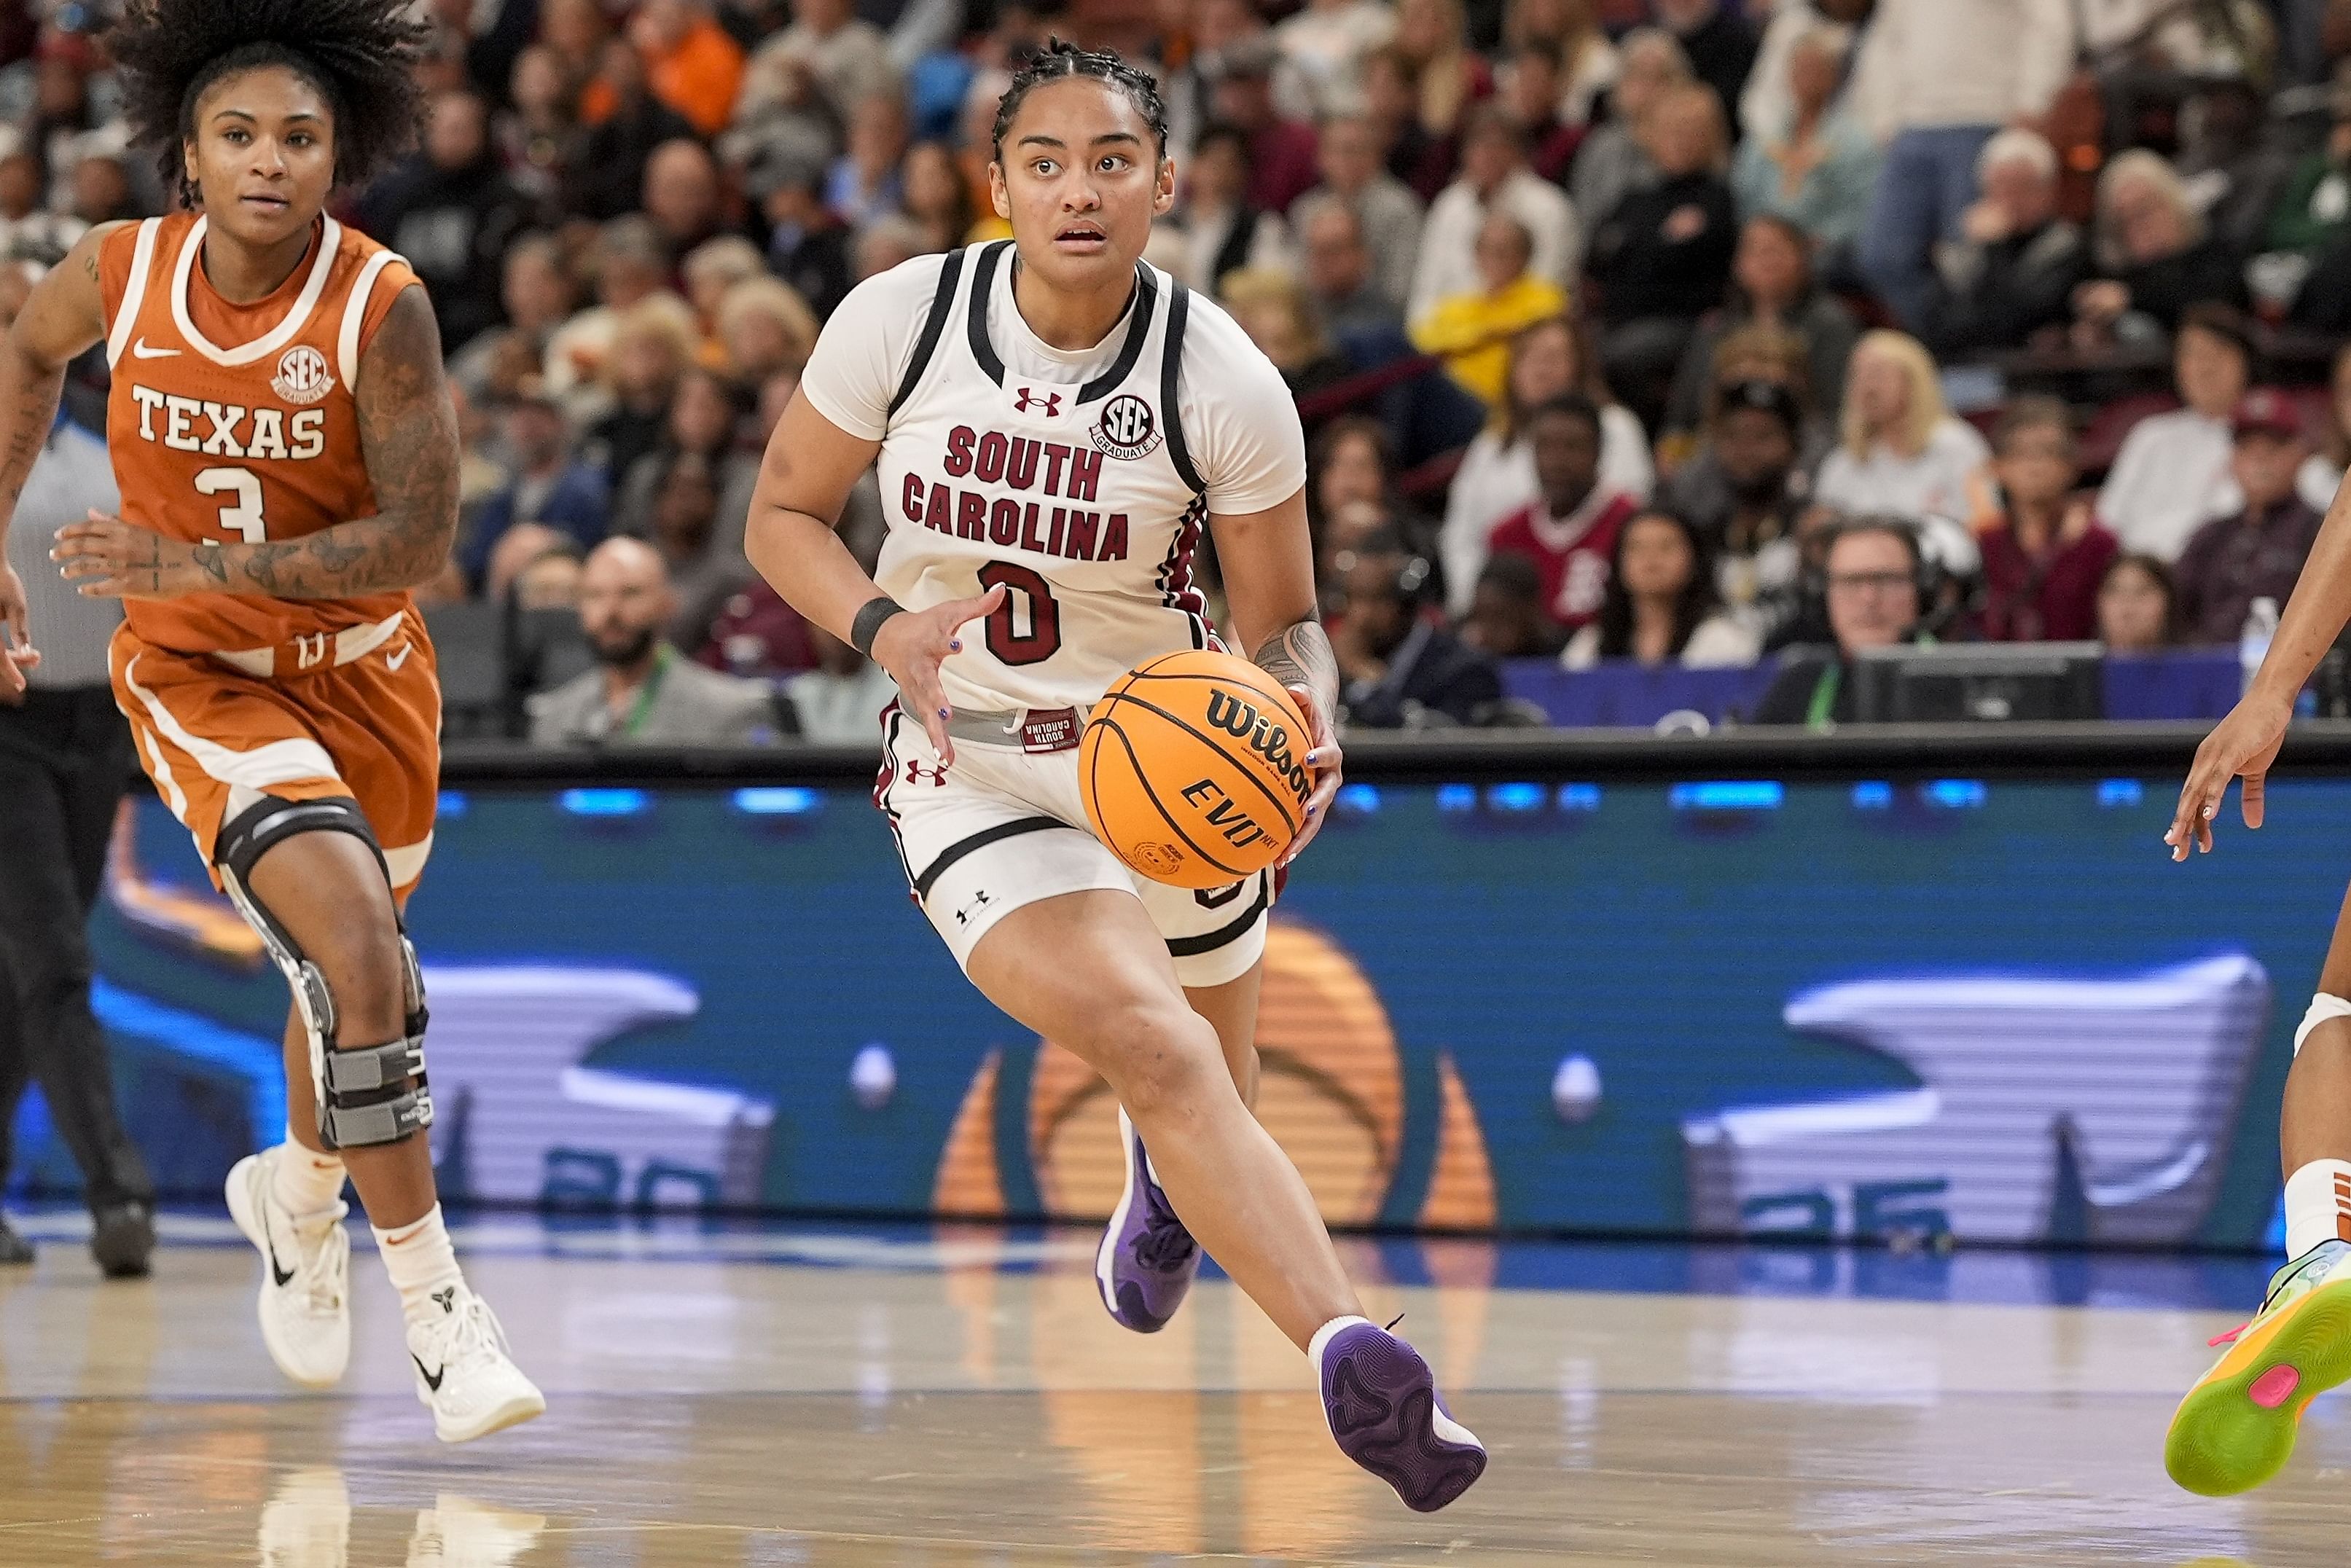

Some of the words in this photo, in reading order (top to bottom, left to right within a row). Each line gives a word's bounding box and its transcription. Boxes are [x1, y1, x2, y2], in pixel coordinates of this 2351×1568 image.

[283, 350, 322, 391] SEC
[132, 383, 324, 460] TEXAS
[1096, 435, 1151, 459] GRADUATE
[1105, 397, 1149, 444] SEC
[944, 425, 1104, 502] SOUTH
[193, 467, 267, 546] 3
[902, 471, 1129, 562] CAROLINA
[977, 560, 1062, 666] 0
[1025, 719, 1071, 735] CAROLINA
[1035, 731, 1064, 744] SOUTH
[1240, 745, 1265, 767] INDOOR
[1181, 778, 1264, 848] EVO
[1259, 833, 1280, 851] NXT
